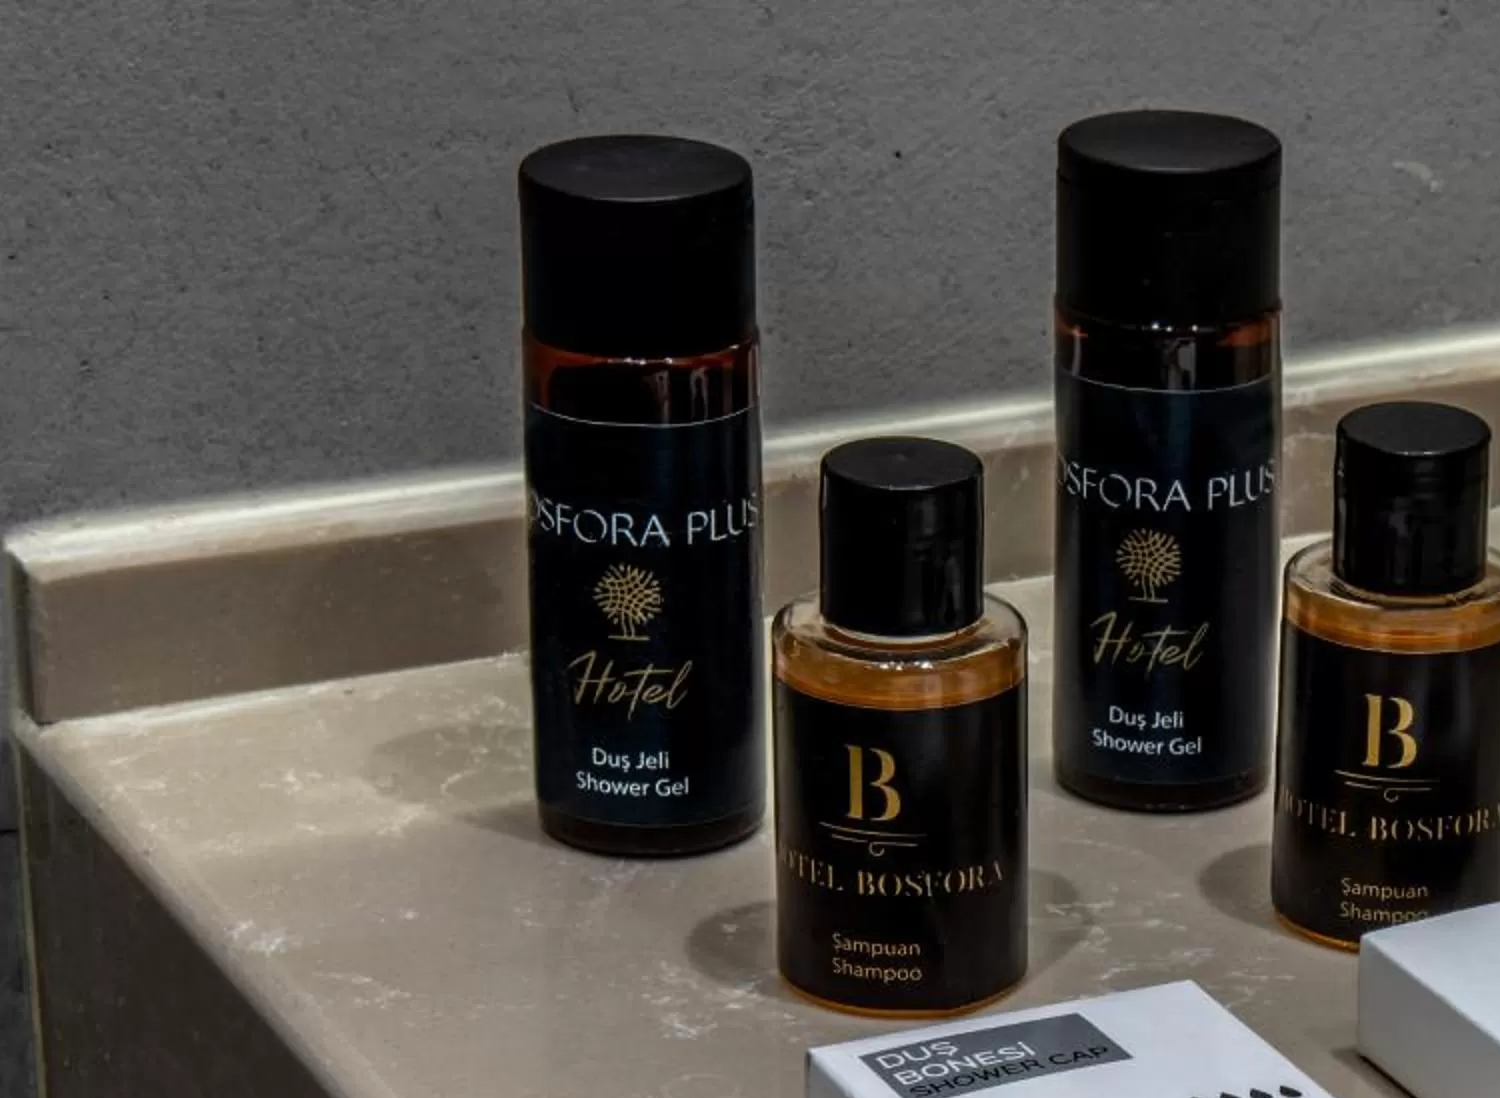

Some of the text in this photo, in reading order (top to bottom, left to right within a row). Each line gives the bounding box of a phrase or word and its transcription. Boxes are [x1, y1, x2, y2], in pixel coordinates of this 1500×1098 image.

[1207, 459, 1275, 510] PLUS
[687, 491, 758, 546] PLUS
[1090, 611, 1209, 676] Hotel
[566, 650, 693, 721] Hotel
[1091, 728, 1202, 756] Shower Gel
[1109, 705, 1184, 730] Duş Jeli
[1361, 693, 1418, 769] B
[576, 770, 689, 797] Shower Gel
[591, 747, 670, 772] Duş Jeli
[844, 744, 901, 821] B
[857, 860, 1003, 897] BOSFORA
[832, 957, 923, 983] Shampoo
[909, 1046, 1109, 1098] SHOWER CAP
